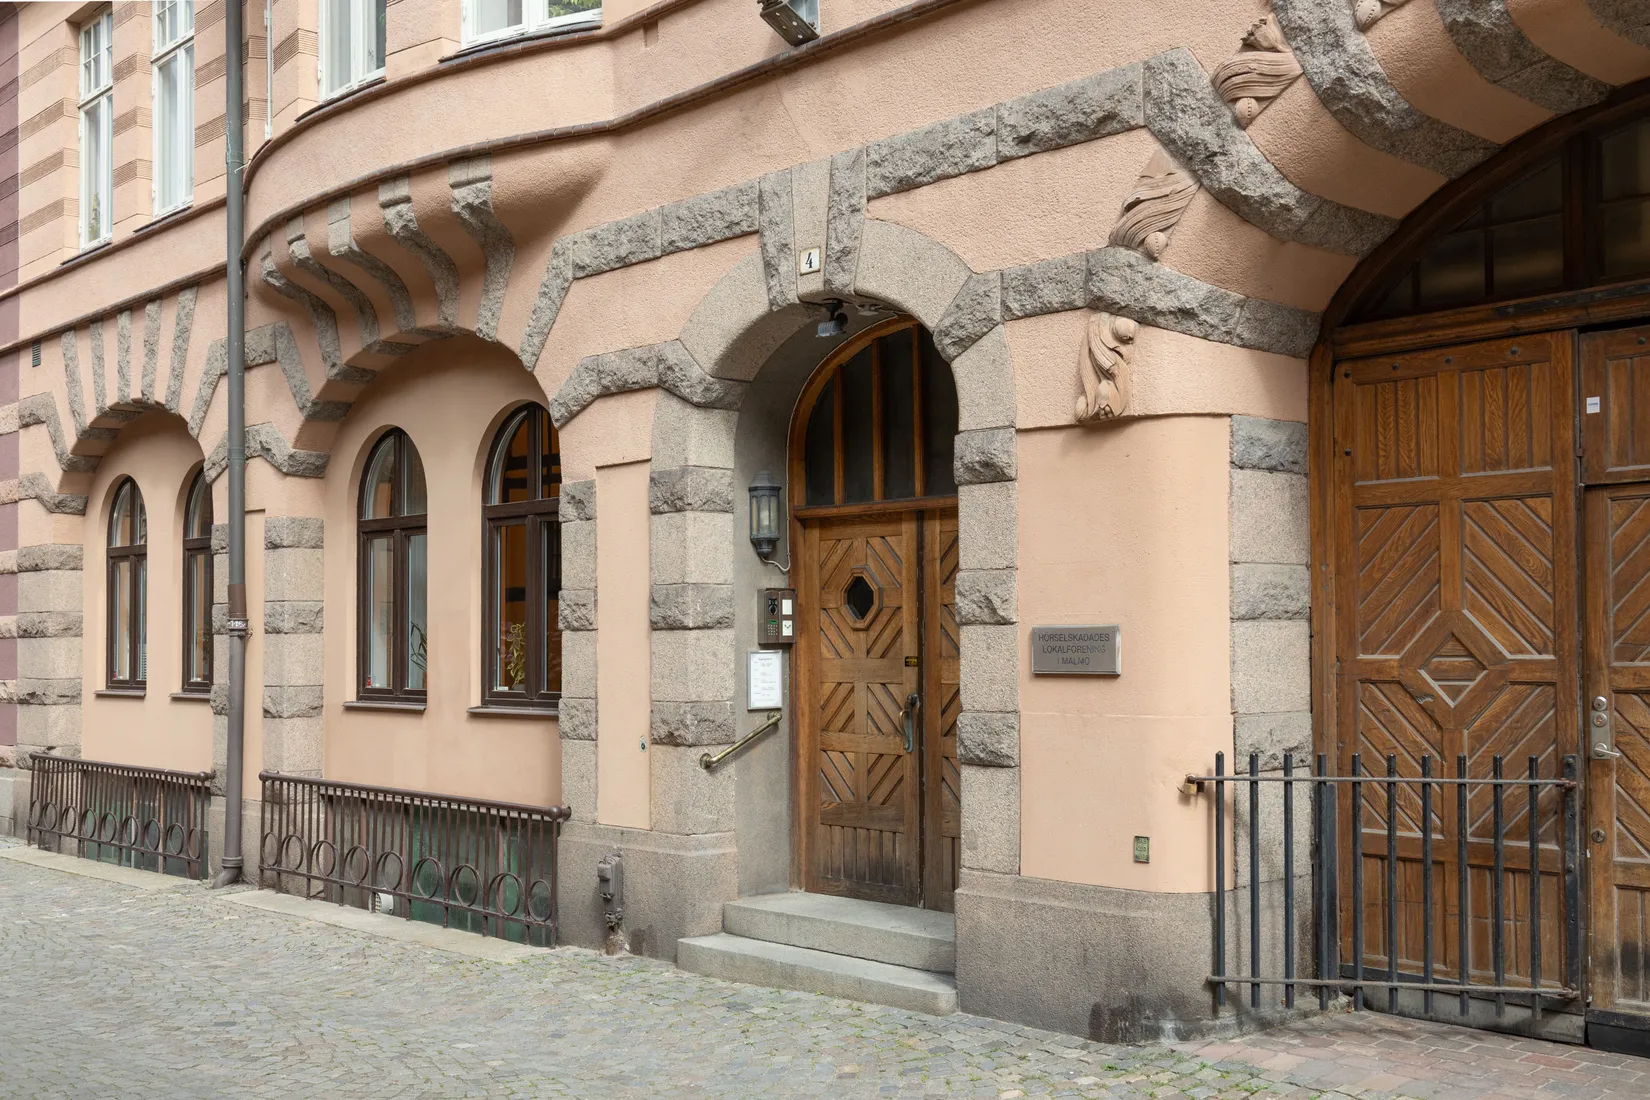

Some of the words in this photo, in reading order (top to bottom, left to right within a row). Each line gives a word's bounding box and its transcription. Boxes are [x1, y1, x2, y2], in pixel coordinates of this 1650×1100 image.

[805, 252, 813, 269] 4
[1038, 631, 1110, 642] HÖRSELSKADADES
[1061, 655, 1091, 666] MALMÖ
